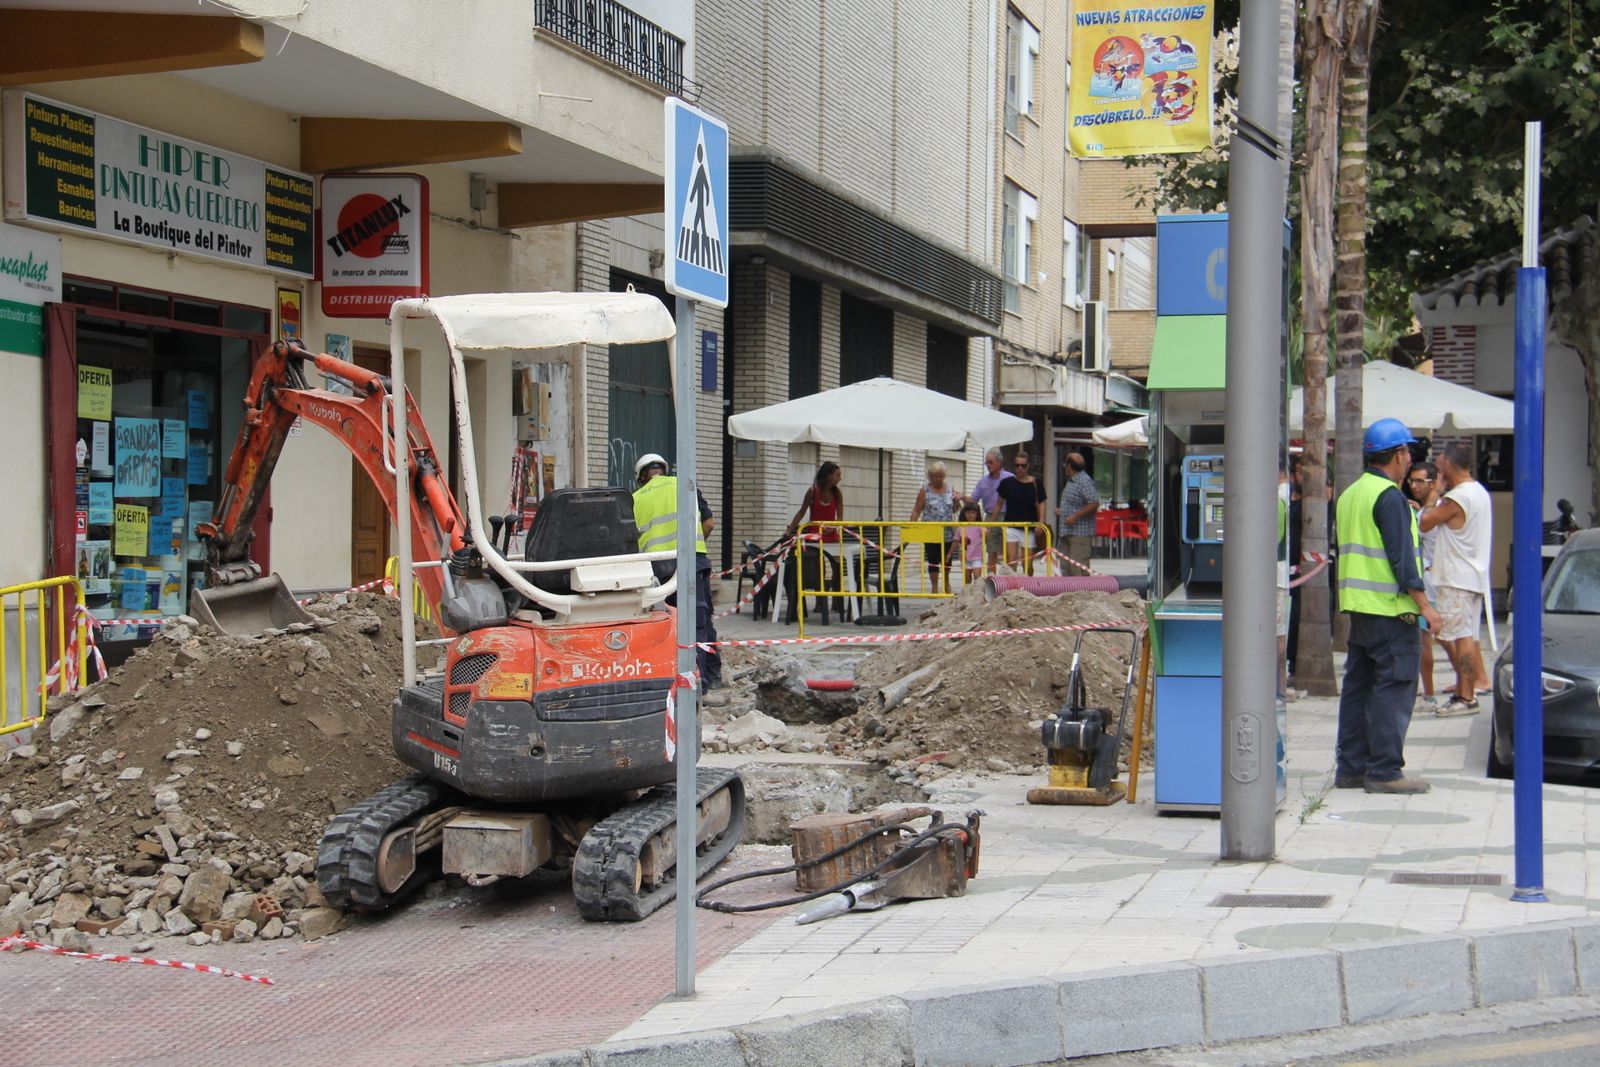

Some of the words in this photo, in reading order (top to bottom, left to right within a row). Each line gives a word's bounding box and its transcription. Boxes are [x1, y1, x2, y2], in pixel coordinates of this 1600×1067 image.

[1076, 10, 1121, 26] NUEVAS
[27, 102, 59, 125] Pintura
[61, 113, 94, 136] Plastica
[30, 127, 94, 158] Revestimientos
[37, 152, 94, 180] Herramientas
[138, 134, 231, 190] HIPER
[57, 178, 95, 200] Esmaltes
[266, 173, 289, 189] Pintura
[289, 180, 313, 197] Plastica
[100, 163, 181, 215] PINTURAS
[185, 185, 261, 233] GUERRERO
[266, 192, 311, 214] Revestimientos
[58, 200, 96, 222] Barnices
[266, 211, 307, 232] Herramientas
[114, 211, 130, 232] La
[135, 215, 191, 247] Boutique
[194, 228, 214, 250] del
[217, 234, 252, 258] Pintor
[327, 194, 411, 258] TITANLUX
[266, 230, 294, 247] Esmaltes
[266, 248, 293, 264] Barnices
[332, 269, 339, 277] la
[341, 269, 365, 277] marca
[367, 268, 377, 277] de
[379, 269, 409, 278] pinturas
[80, 370, 111, 387] OFERTA
[309, 401, 342, 423] Kubota
[117, 509, 147, 524] OFERTA
[585, 659, 652, 680] Kubota
